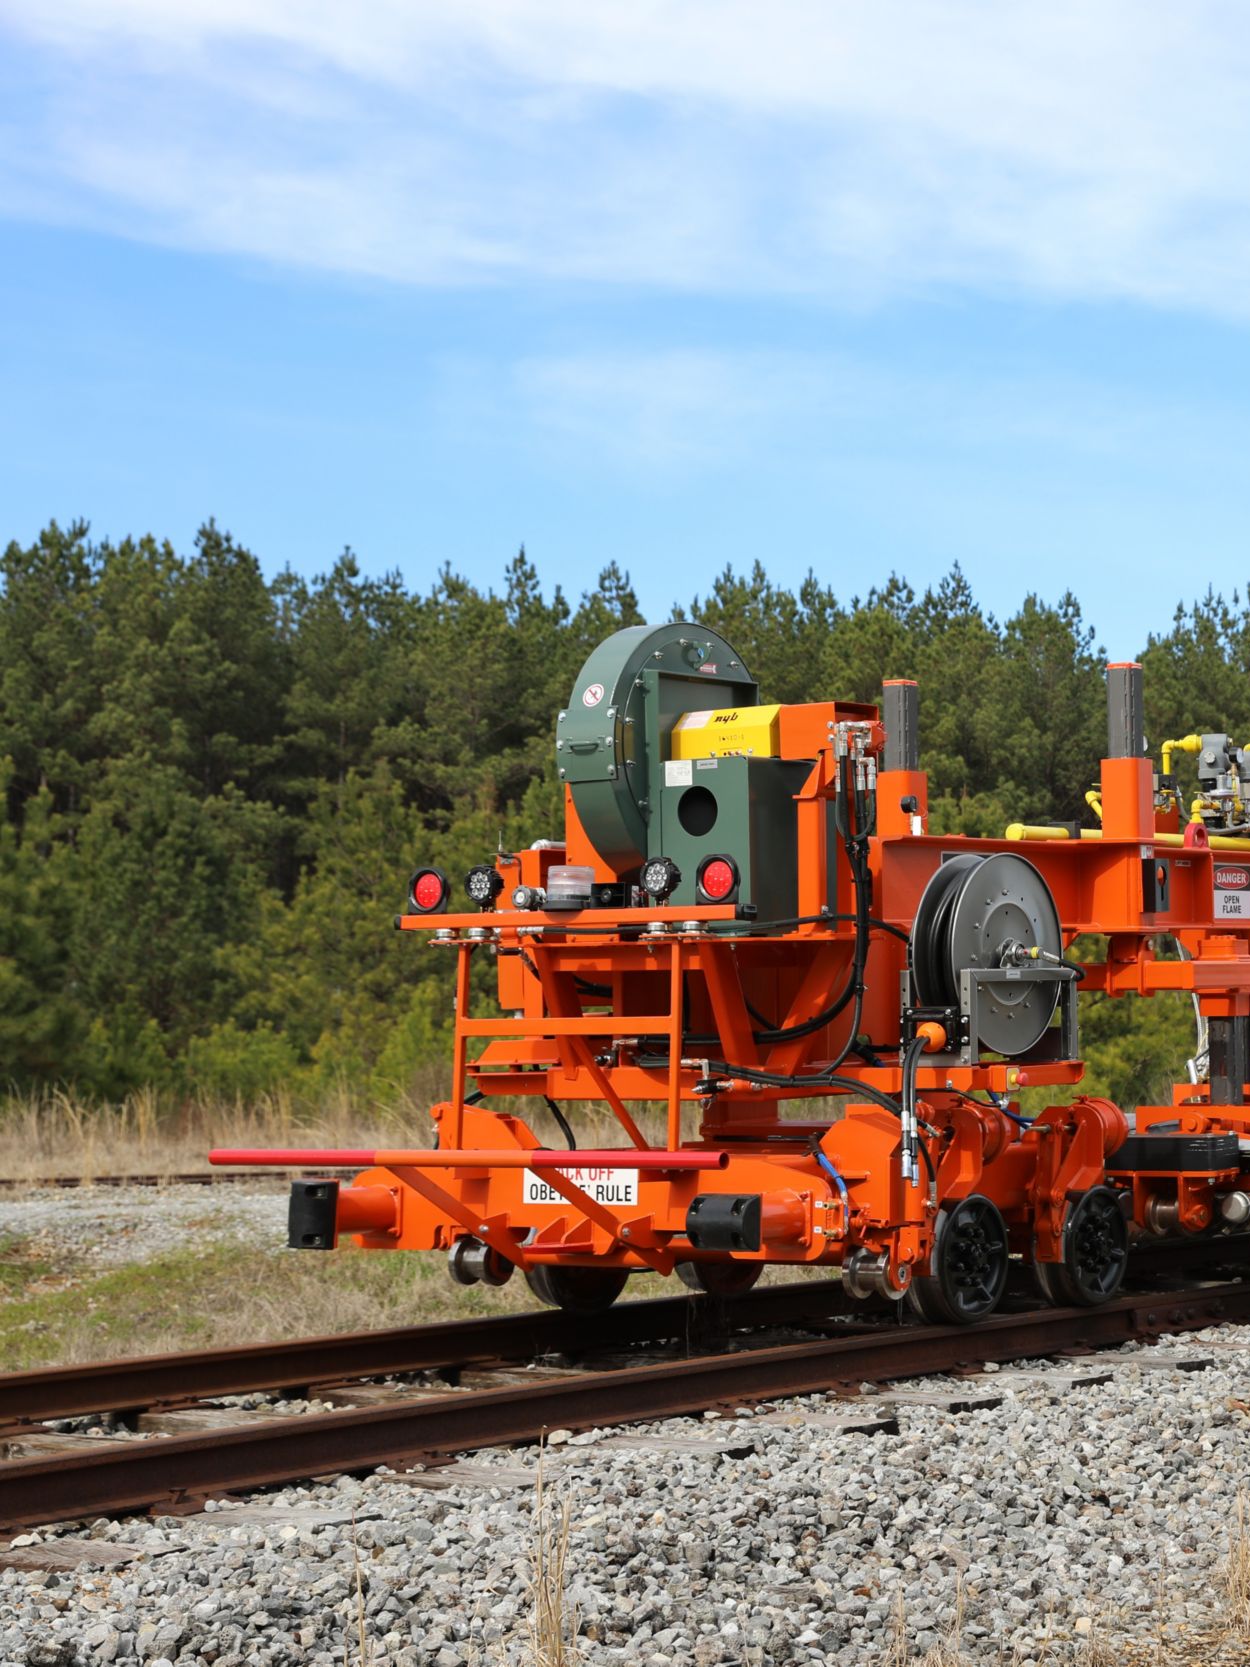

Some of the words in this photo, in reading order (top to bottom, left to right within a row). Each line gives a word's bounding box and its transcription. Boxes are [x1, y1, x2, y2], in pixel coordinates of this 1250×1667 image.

[714, 712, 739, 724] nyb
[1216, 872, 1247, 884] DANGER
[1223, 895, 1240, 905] OPEN
[1222, 904, 1242, 914] FLAME
[589, 1167, 615, 1182] OFF
[530, 1184, 563, 1201] OBE
[596, 1185, 632, 1202] RULE
